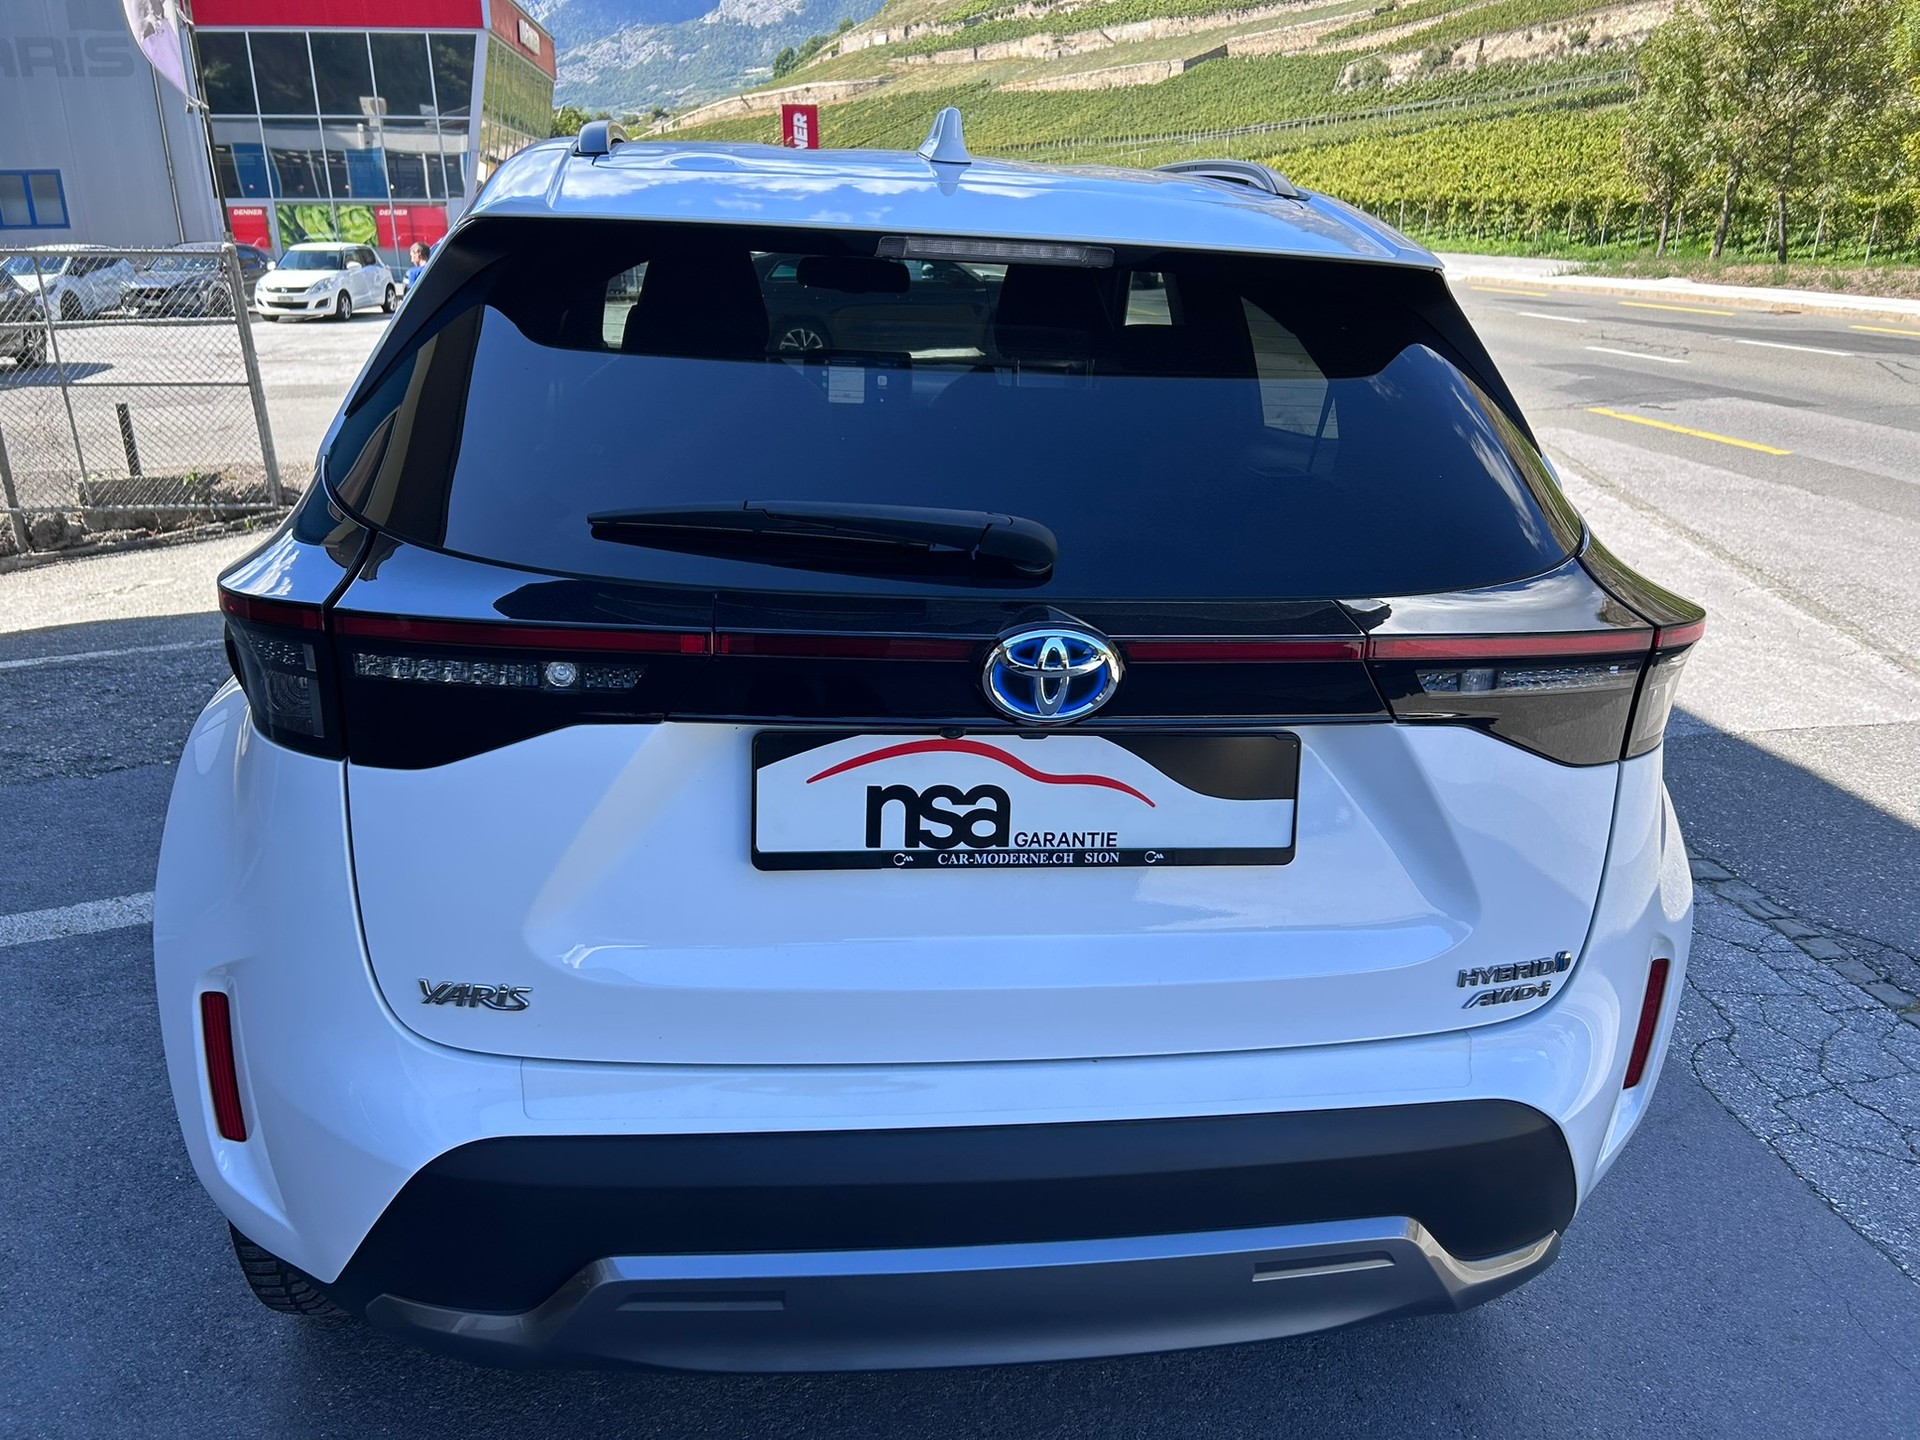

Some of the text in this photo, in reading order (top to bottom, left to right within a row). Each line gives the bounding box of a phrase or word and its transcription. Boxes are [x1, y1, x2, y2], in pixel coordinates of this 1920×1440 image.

[233, 208, 263, 216] DENNER
[865, 784, 1118, 849] nsa GARANTIE
[937, 852, 1074, 865] CAR-MODERNE.CH
[1084, 852, 1120, 864] SION
[1456, 957, 1557, 988] HYBRID
